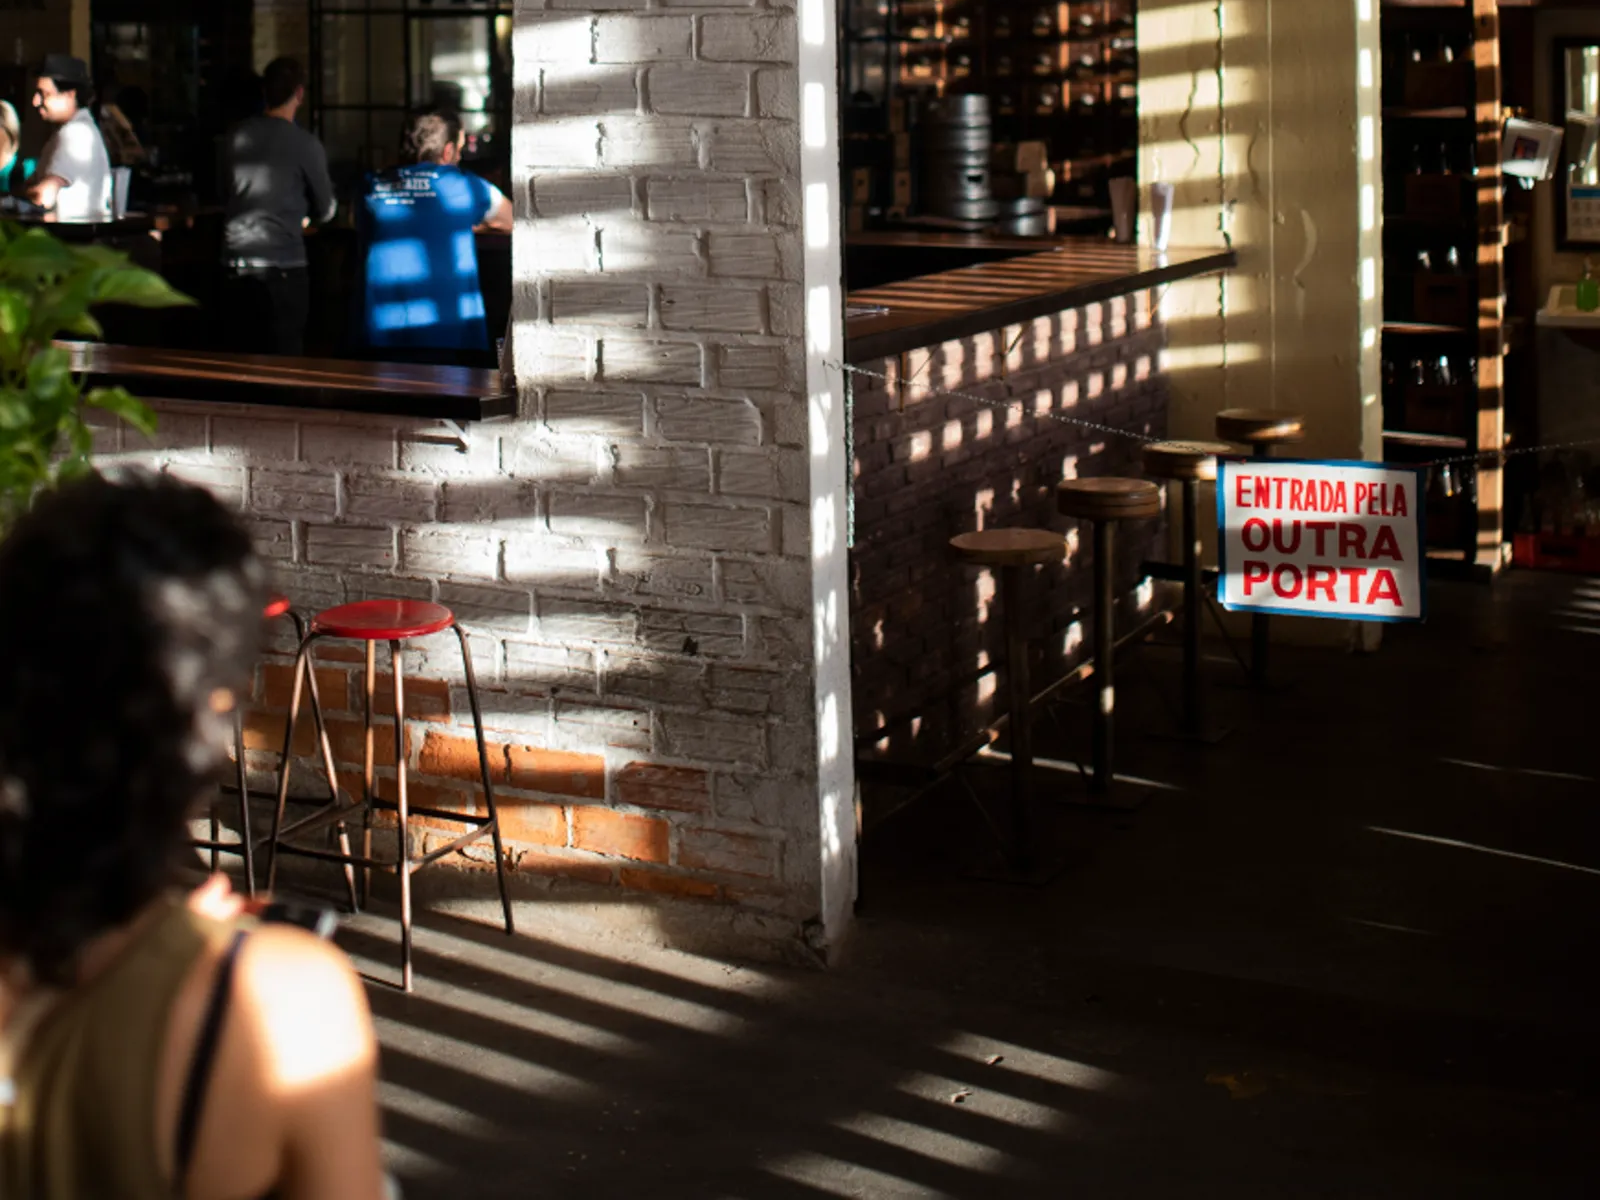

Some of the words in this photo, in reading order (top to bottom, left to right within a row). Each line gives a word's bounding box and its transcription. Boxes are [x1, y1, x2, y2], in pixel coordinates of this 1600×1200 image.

[1235, 475, 1347, 513] ENTRADA
[1354, 482, 1408, 517] PELA
[1241, 517, 1404, 561] OUTRA
[1243, 560, 1404, 607] PORTA
